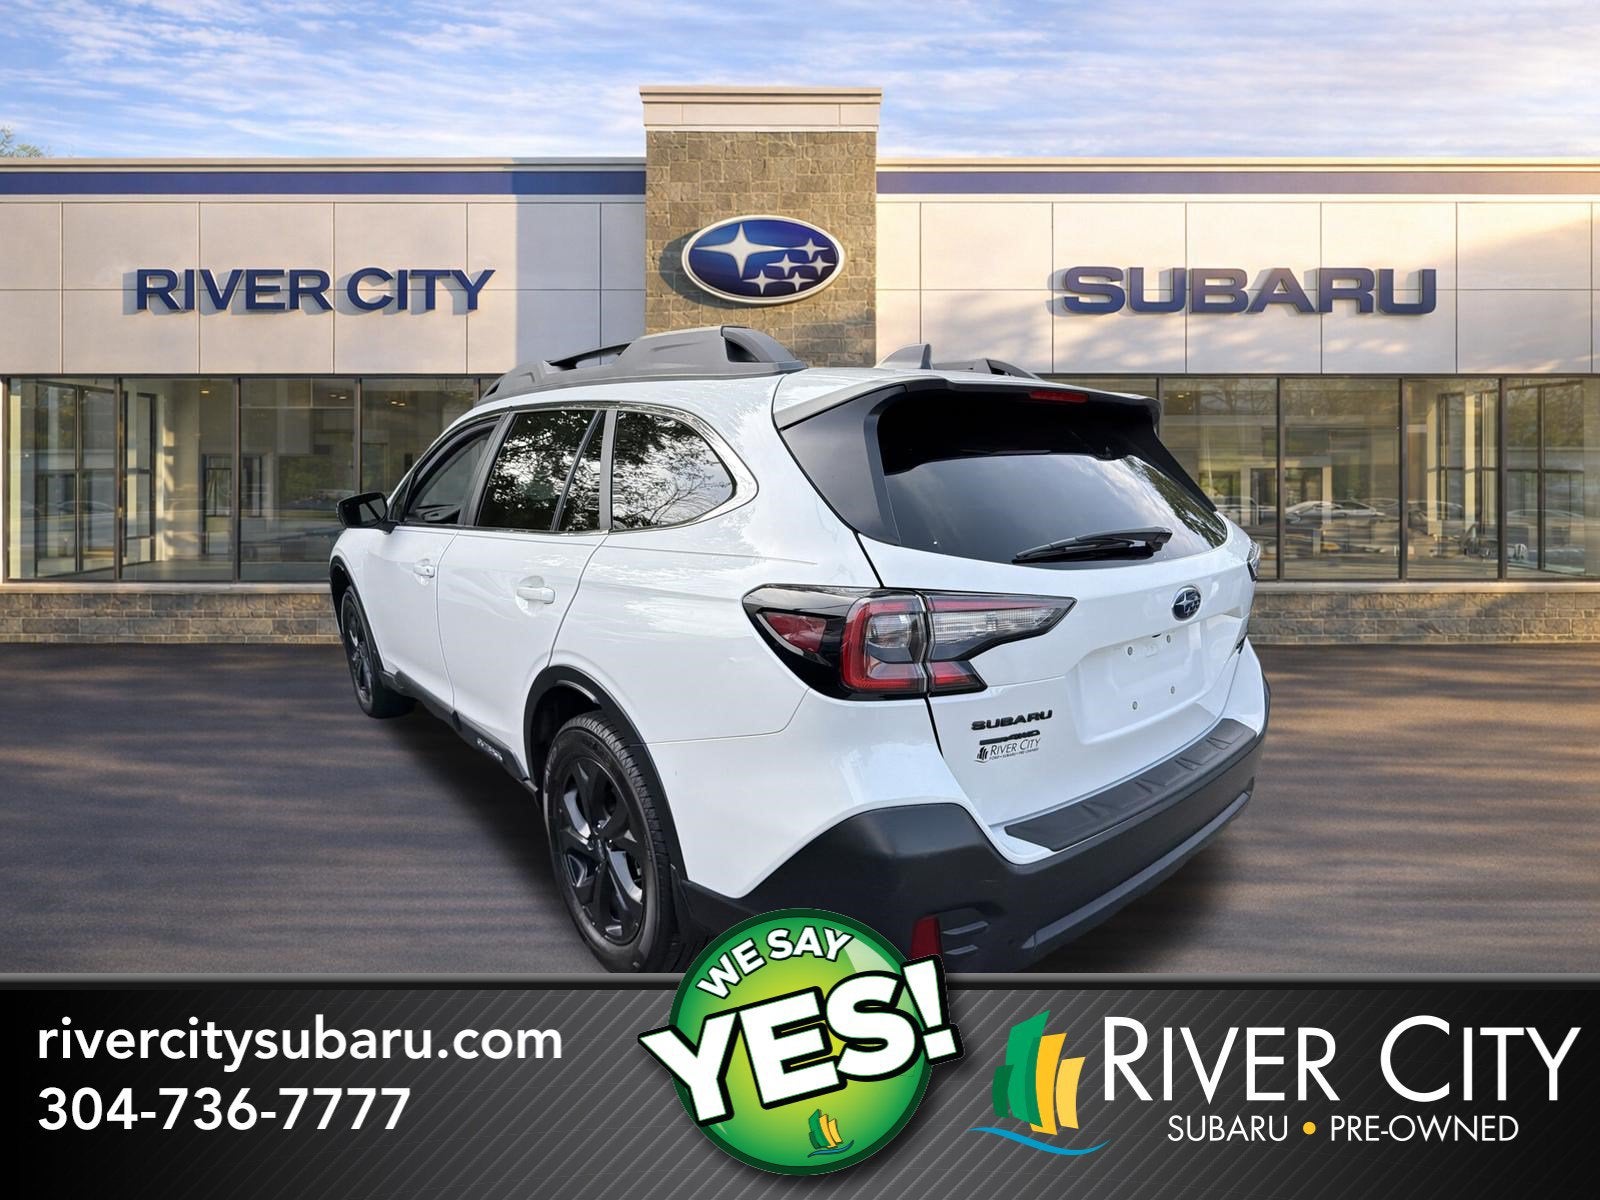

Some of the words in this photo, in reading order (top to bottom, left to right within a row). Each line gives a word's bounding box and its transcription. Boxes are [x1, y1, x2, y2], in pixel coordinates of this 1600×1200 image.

[136, 268, 334, 311] RIVER
[346, 267, 496, 311] CITY
[1063, 266, 1438, 315] SUBARU
[971, 709, 1053, 731] SUBARU
[990, 743, 1018, 756] RIVER
[1020, 738, 1041, 751] CITY
